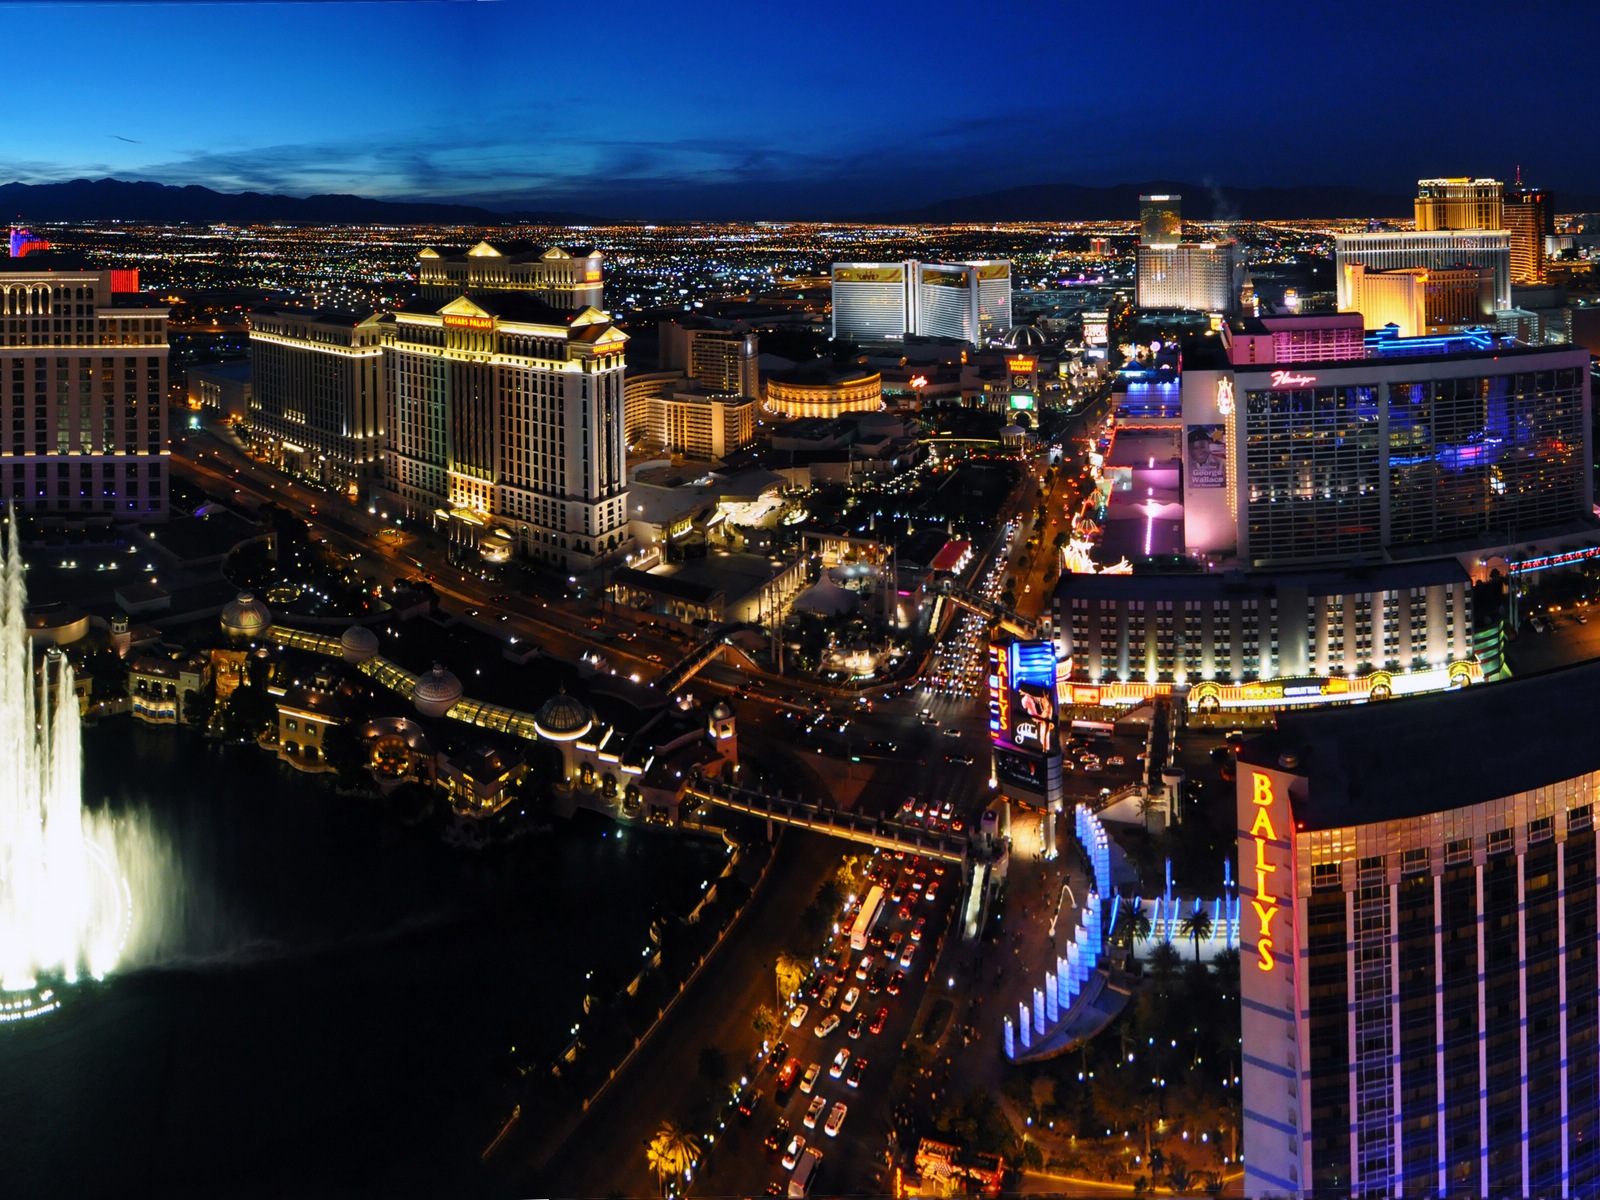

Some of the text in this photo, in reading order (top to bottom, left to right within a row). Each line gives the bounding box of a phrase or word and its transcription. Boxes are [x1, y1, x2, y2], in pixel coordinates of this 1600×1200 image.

[444, 317, 491, 328] CAESARS PALACE
[1271, 370, 1316, 387] Flamingo
[1192, 469, 1222, 477] George
